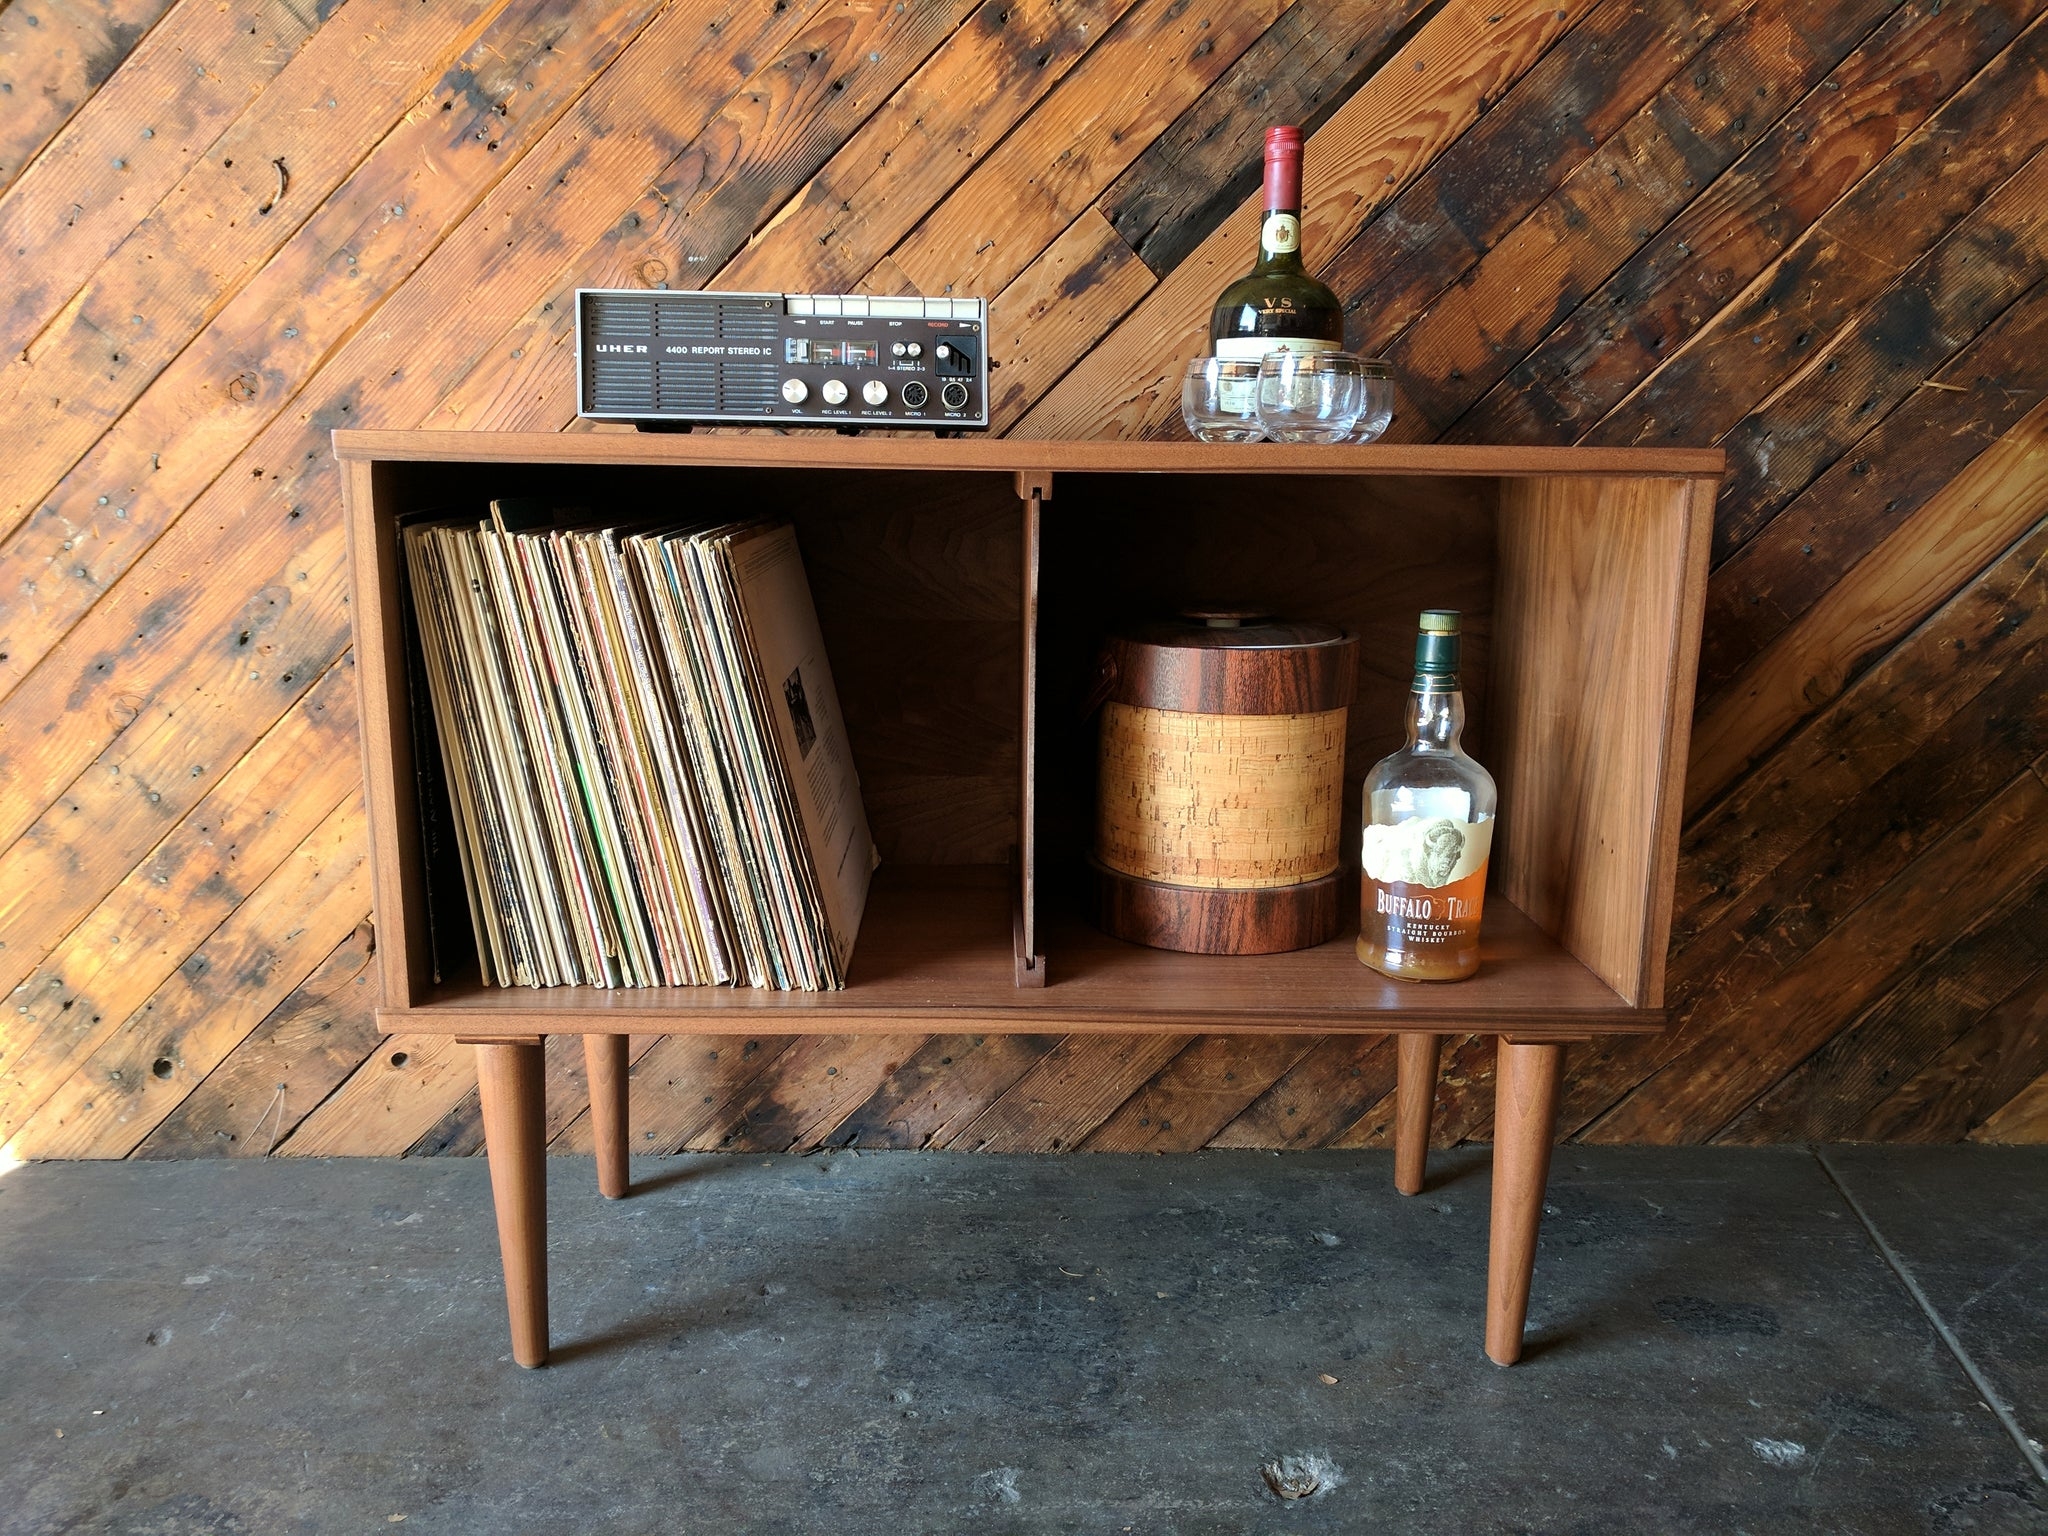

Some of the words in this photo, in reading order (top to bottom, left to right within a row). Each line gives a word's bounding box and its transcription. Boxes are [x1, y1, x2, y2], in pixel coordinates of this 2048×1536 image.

[595, 344, 648, 353] UHER
[666, 346, 687, 354] 4400
[728, 347, 760, 355] STEREO
[763, 347, 772, 355] IC
[1377, 888, 1431, 919] BUFFALO
[1387, 926, 1428, 936] STRAIGHT
